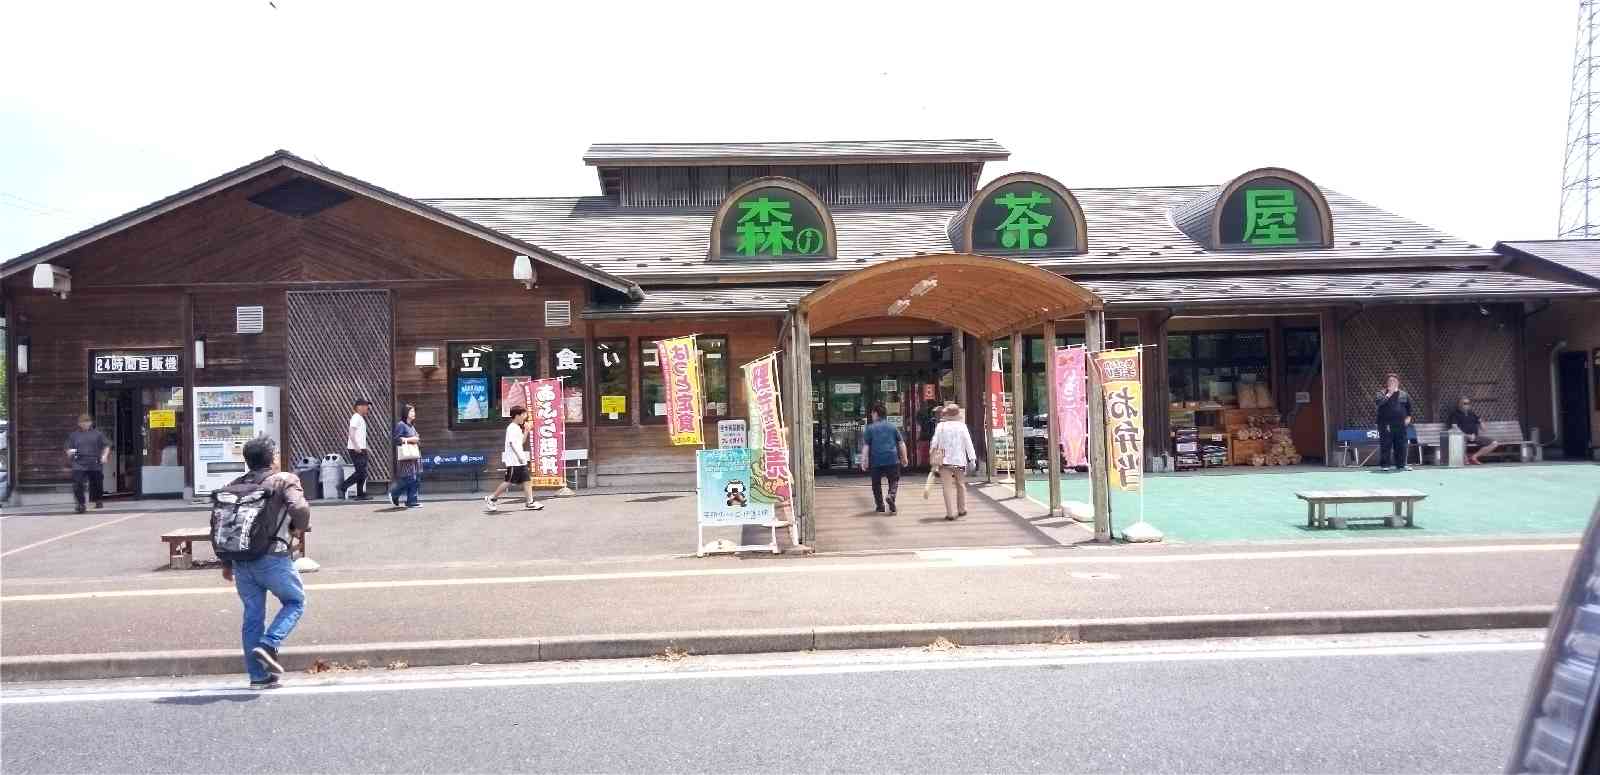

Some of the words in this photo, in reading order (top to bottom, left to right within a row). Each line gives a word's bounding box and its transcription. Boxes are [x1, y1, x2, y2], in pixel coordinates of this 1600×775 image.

[995, 192, 1052, 249] 茶
[1243, 189, 1298, 246] 屋
[96, 355, 178, 372] 24時間自販機
